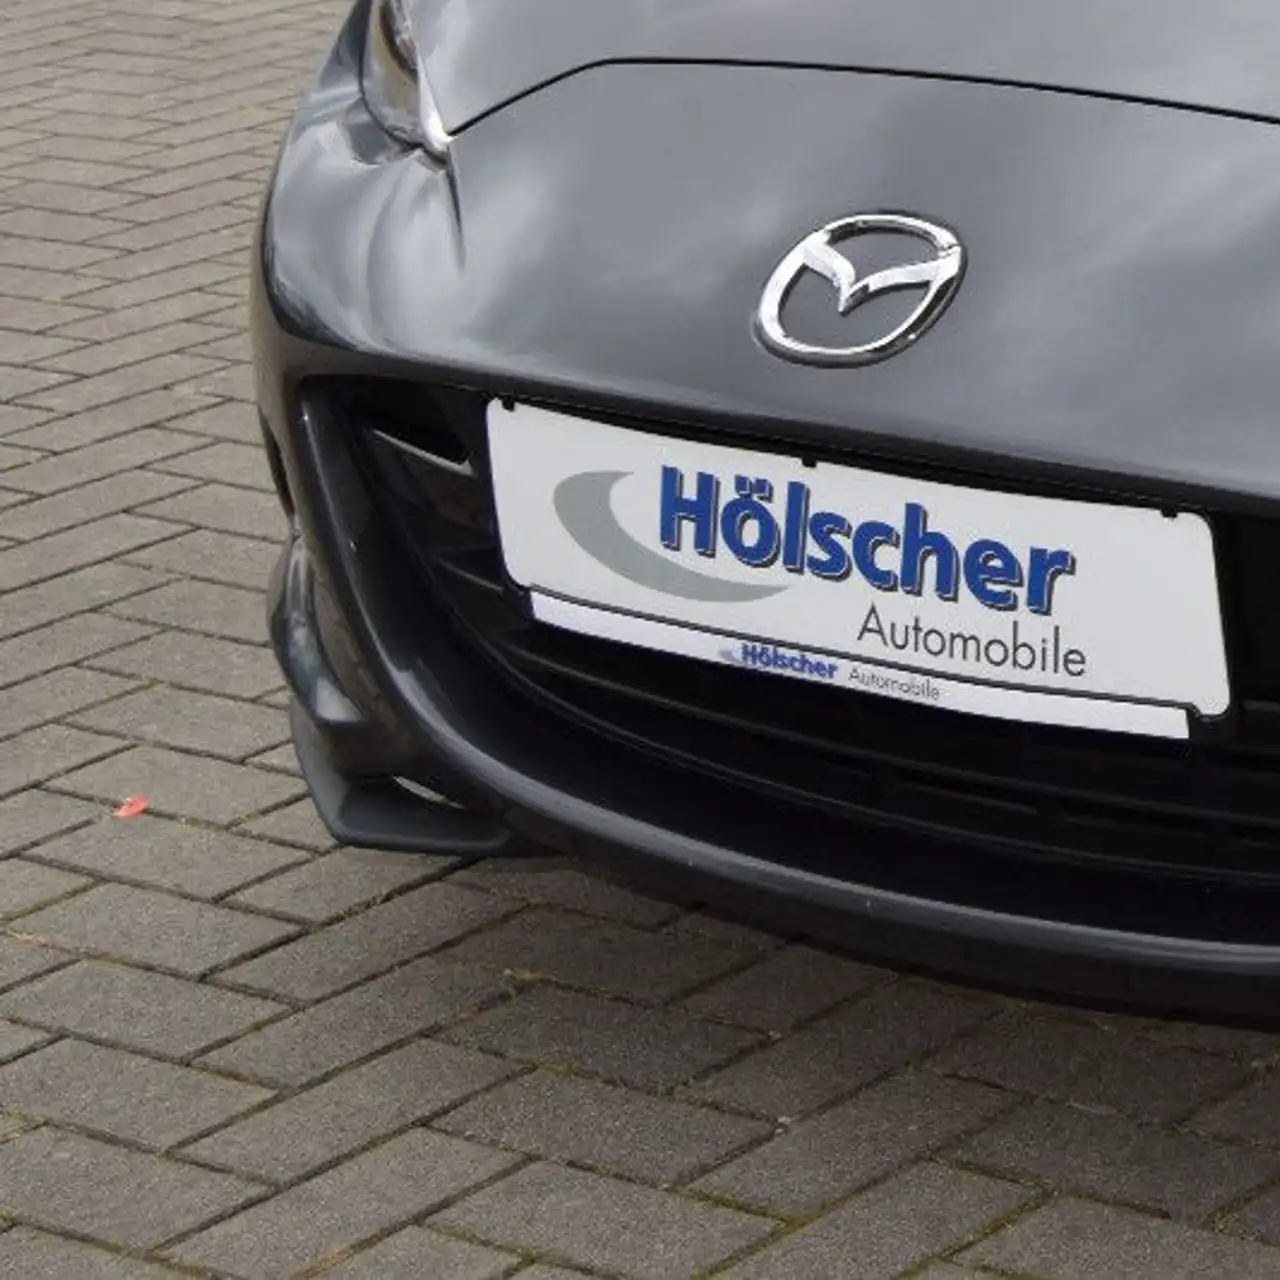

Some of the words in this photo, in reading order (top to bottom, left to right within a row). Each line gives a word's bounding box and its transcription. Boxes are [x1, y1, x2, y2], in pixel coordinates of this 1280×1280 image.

[660, 464, 1077, 616] Hölscher
[740, 642, 838, 680] Hölscher
[847, 666, 941, 702] Automobile
[857, 602, 1087, 678] Automobile
